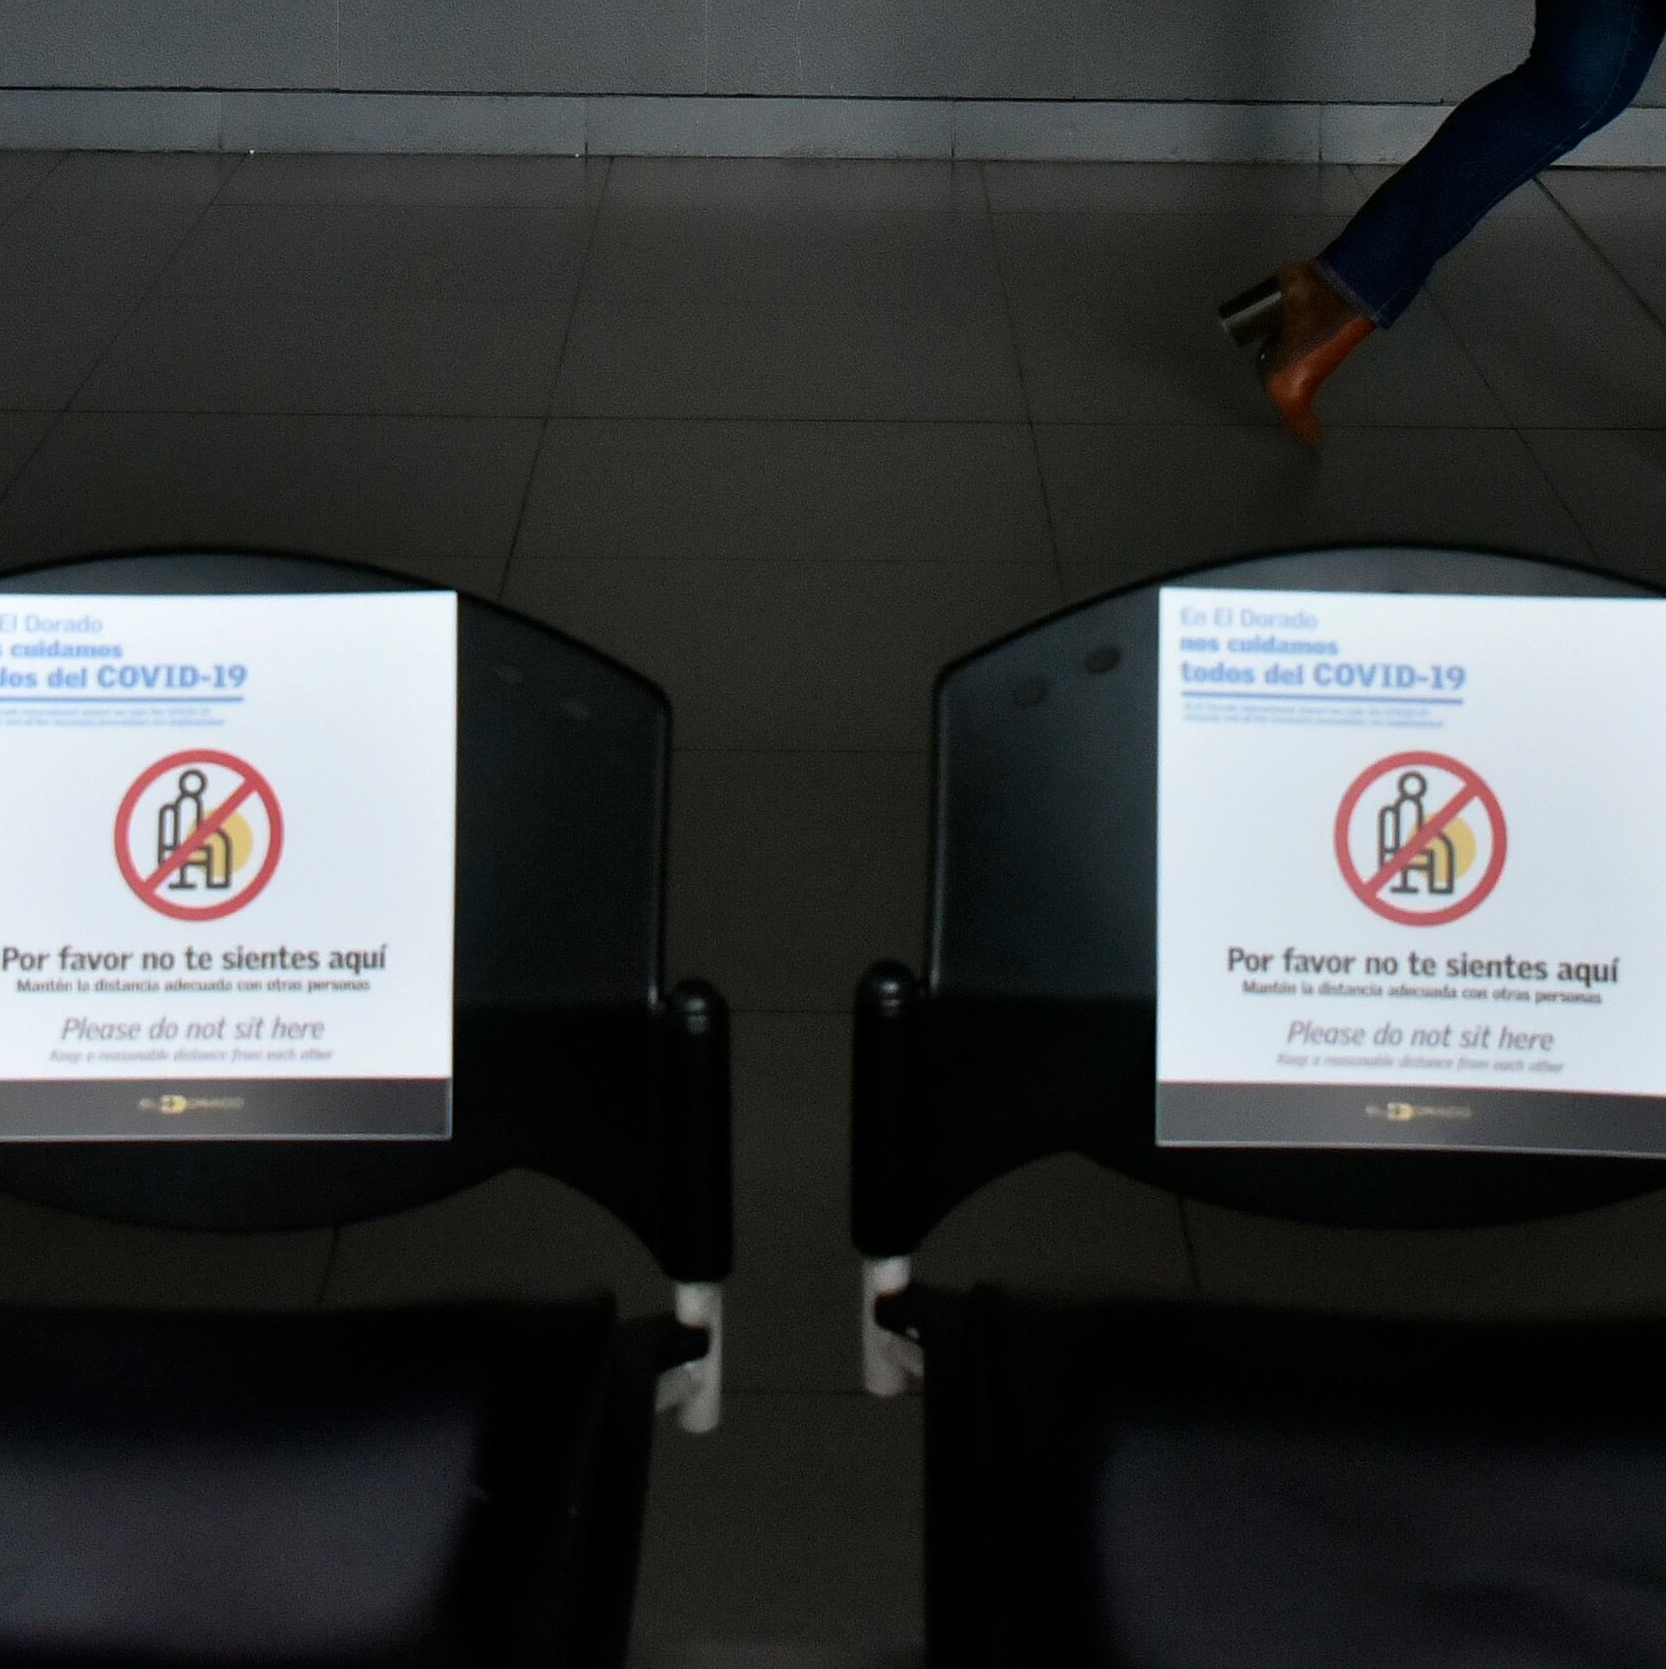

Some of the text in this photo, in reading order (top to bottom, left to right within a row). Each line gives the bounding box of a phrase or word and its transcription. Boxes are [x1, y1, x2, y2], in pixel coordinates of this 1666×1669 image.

[22, 611, 104, 636] Dorado
[1179, 605, 1320, 632] En El Dorado
[9, 639, 124, 660] cuidamos
[1179, 634, 1341, 658] nos cuidamos
[46, 666, 89, 690] del
[96, 663, 249, 690] COVID-19
[1179, 660, 1468, 691] todos del COVID-19
[1, 943, 387, 975] Por favor no te sientes aquí
[1227, 946, 1620, 986] Por favor no te sientes aquí
[60, 1014, 326, 1042] Please do not sit here
[1286, 1019, 1556, 1053] Please do not sit here
